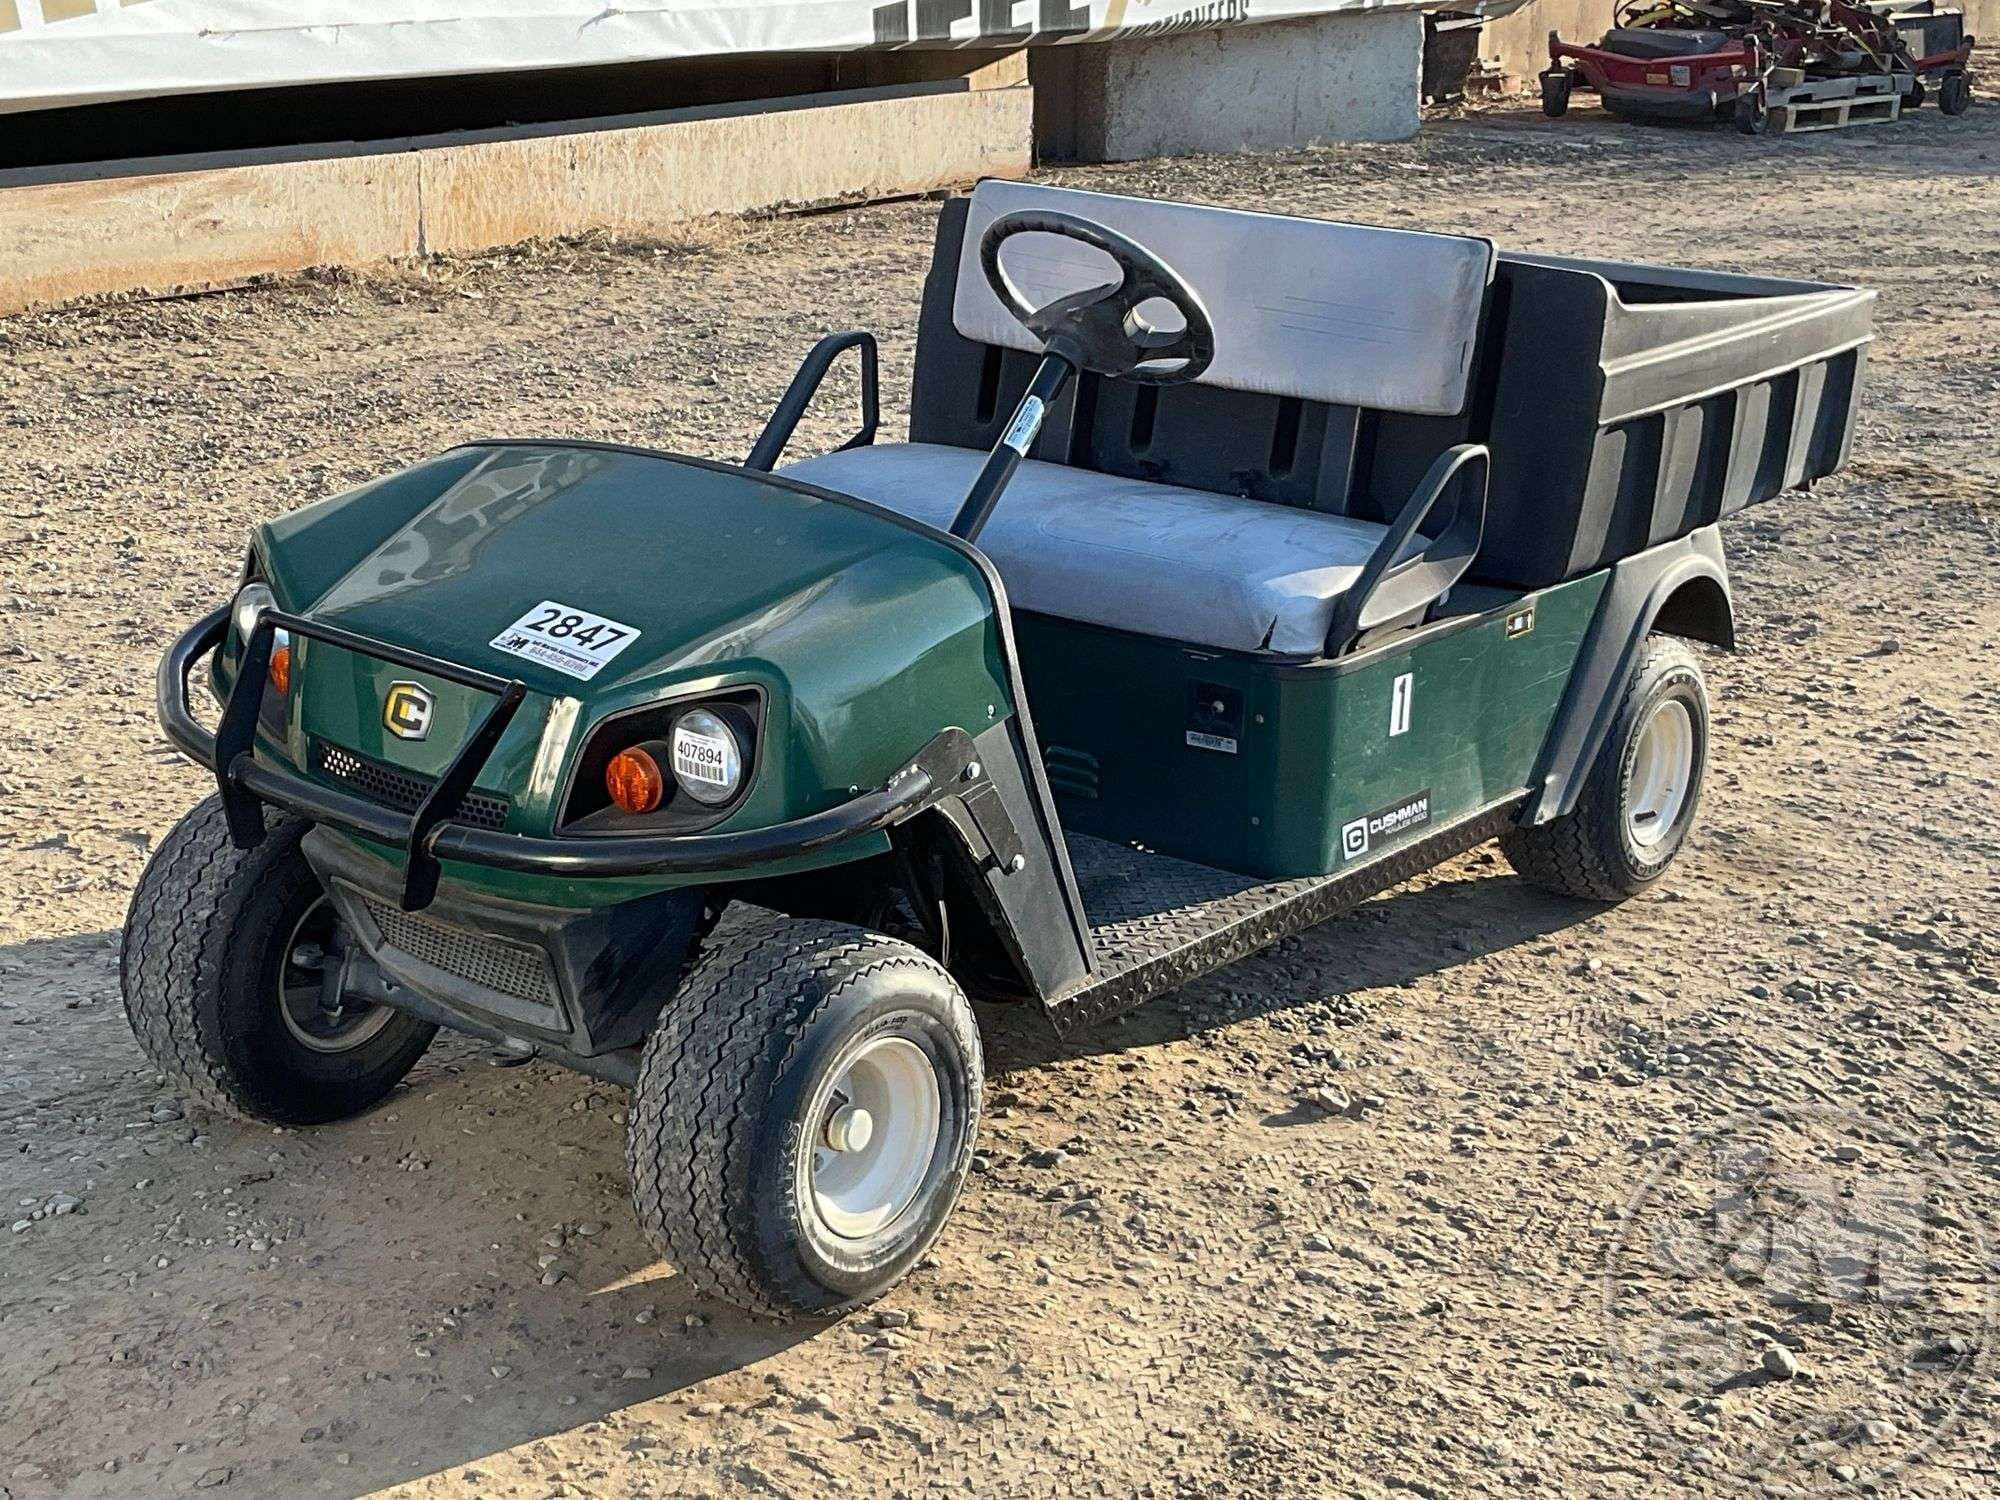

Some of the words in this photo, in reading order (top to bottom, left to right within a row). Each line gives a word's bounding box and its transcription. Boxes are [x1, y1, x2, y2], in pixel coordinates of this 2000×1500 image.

[525, 608, 629, 651] 2847
[1398, 677, 1407, 731] 1
[677, 740, 723, 766] 407894
[1369, 798, 1428, 835] CUSHMAN
